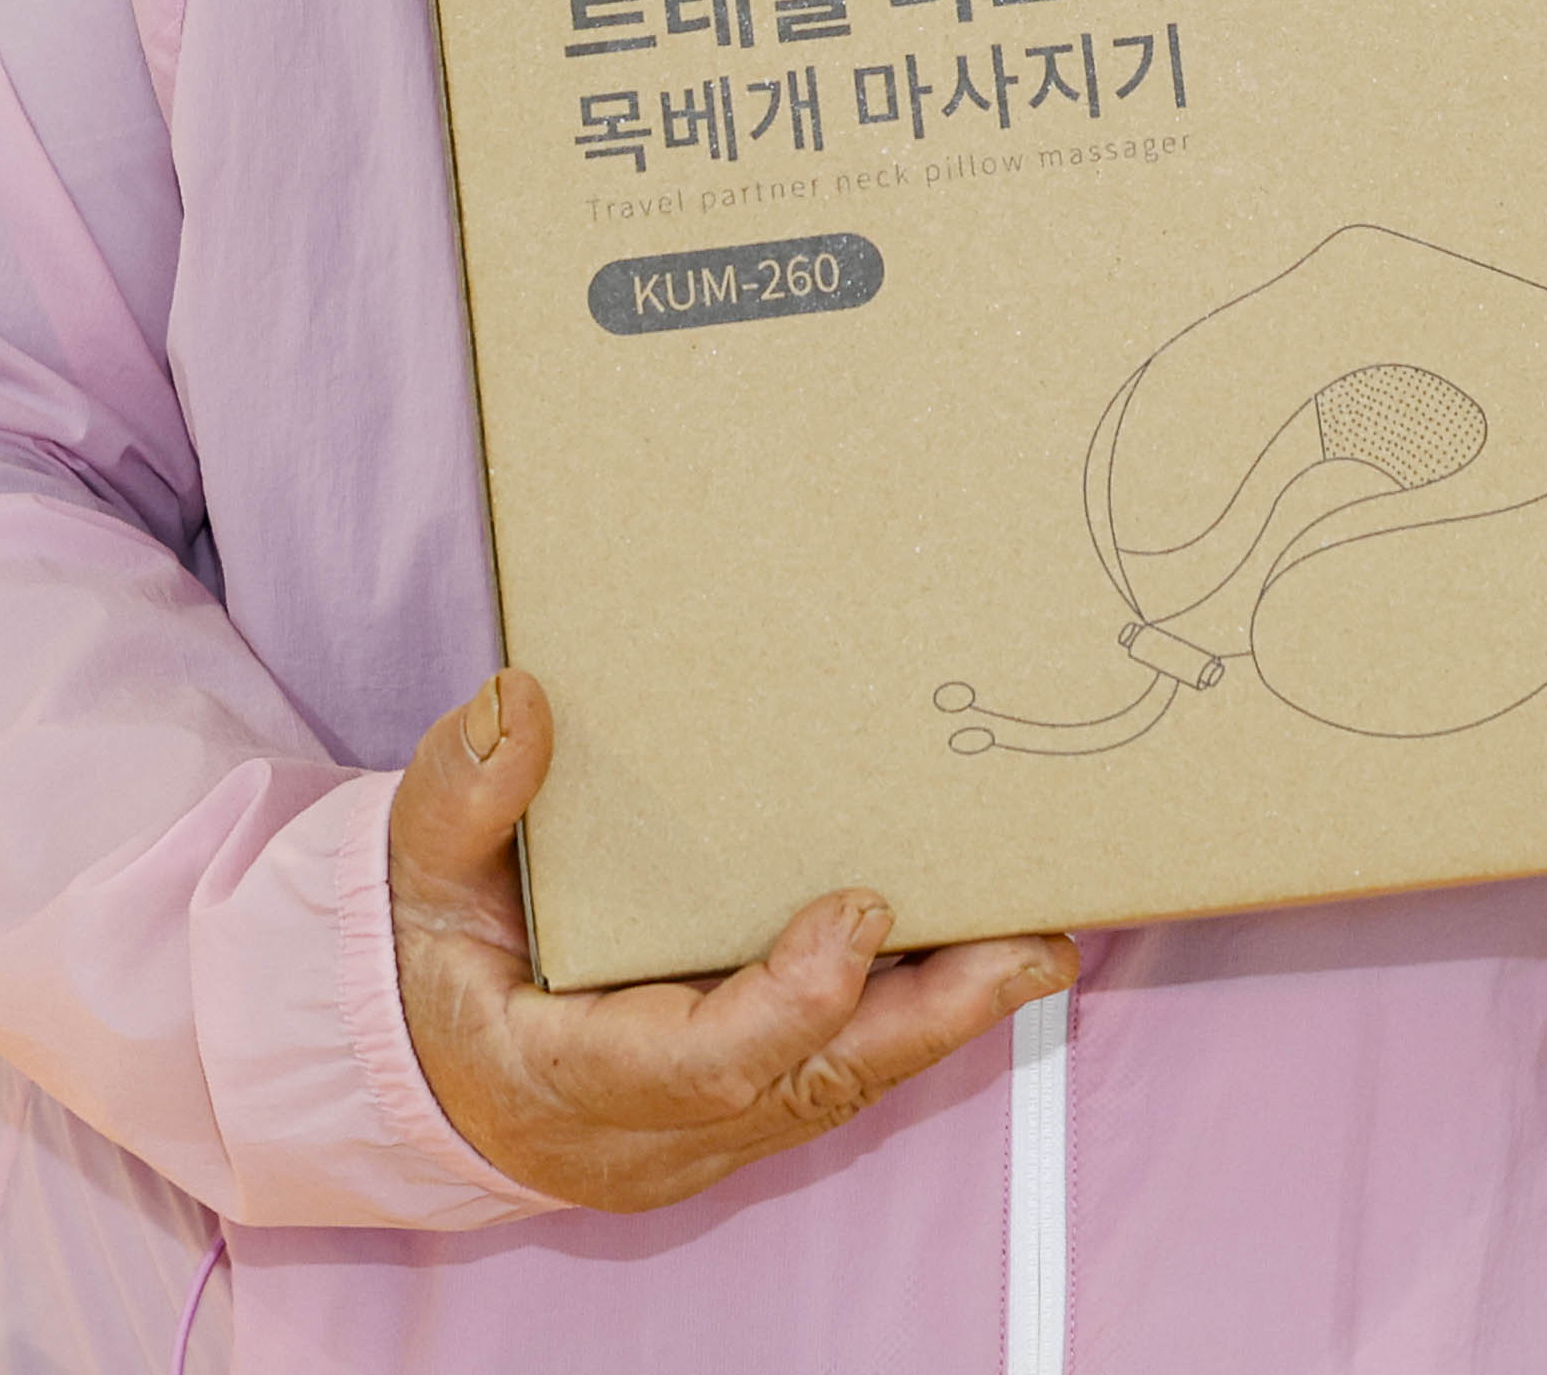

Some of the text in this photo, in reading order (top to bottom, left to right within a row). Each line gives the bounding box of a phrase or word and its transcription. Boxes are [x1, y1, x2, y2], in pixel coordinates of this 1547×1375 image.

[574, 23, 1187, 173] 목베개 마사지기
[585, 132, 1192, 223] Travel partner neck pillow massager
[632, 252, 842, 317] KUM-260
